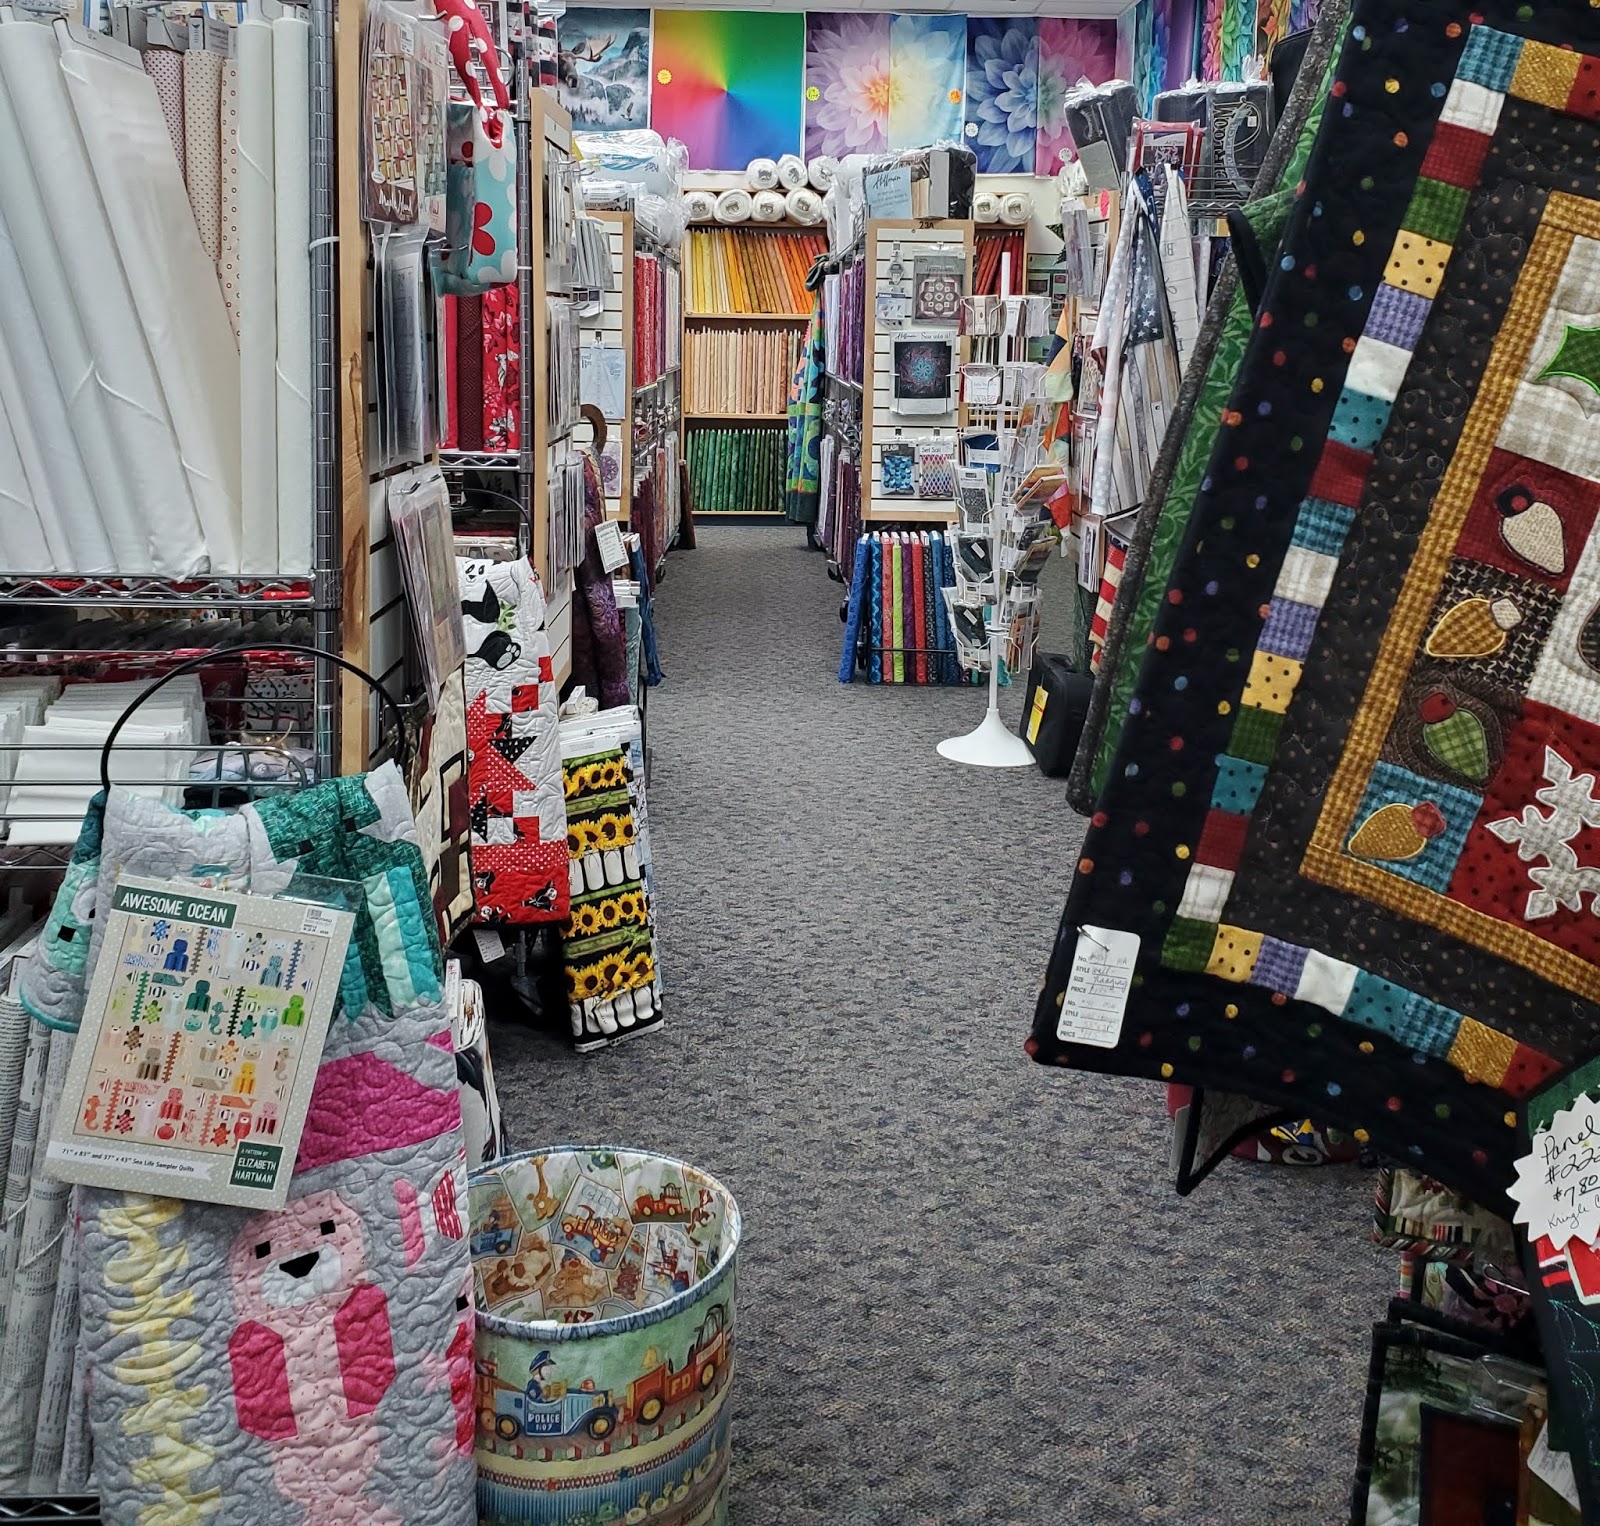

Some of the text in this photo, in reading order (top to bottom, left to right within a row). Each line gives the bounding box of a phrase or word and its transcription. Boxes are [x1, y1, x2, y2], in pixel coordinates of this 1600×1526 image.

[919, 221, 935, 229] 23A
[120, 892, 228, 924] AWESOME OCEAN
[1076, 965, 1091, 974] STYLE
[1073, 975, 1085, 983] SIZE
[1070, 985, 1087, 994] PRICE
[1060, 1030, 1076, 1038] PRICE
[1541, 1114, 1600, 1165] Panel
[155, 1161, 178, 1170] Sampler
[179, 1164, 195, 1173] Quilts
[237, 1157, 277, 1171] ELIZABETH
[234, 1170, 274, 1184] HARTMAN
[671, 1372, 691, 1396] FD
[527, 1413, 560, 1424] POLICE
